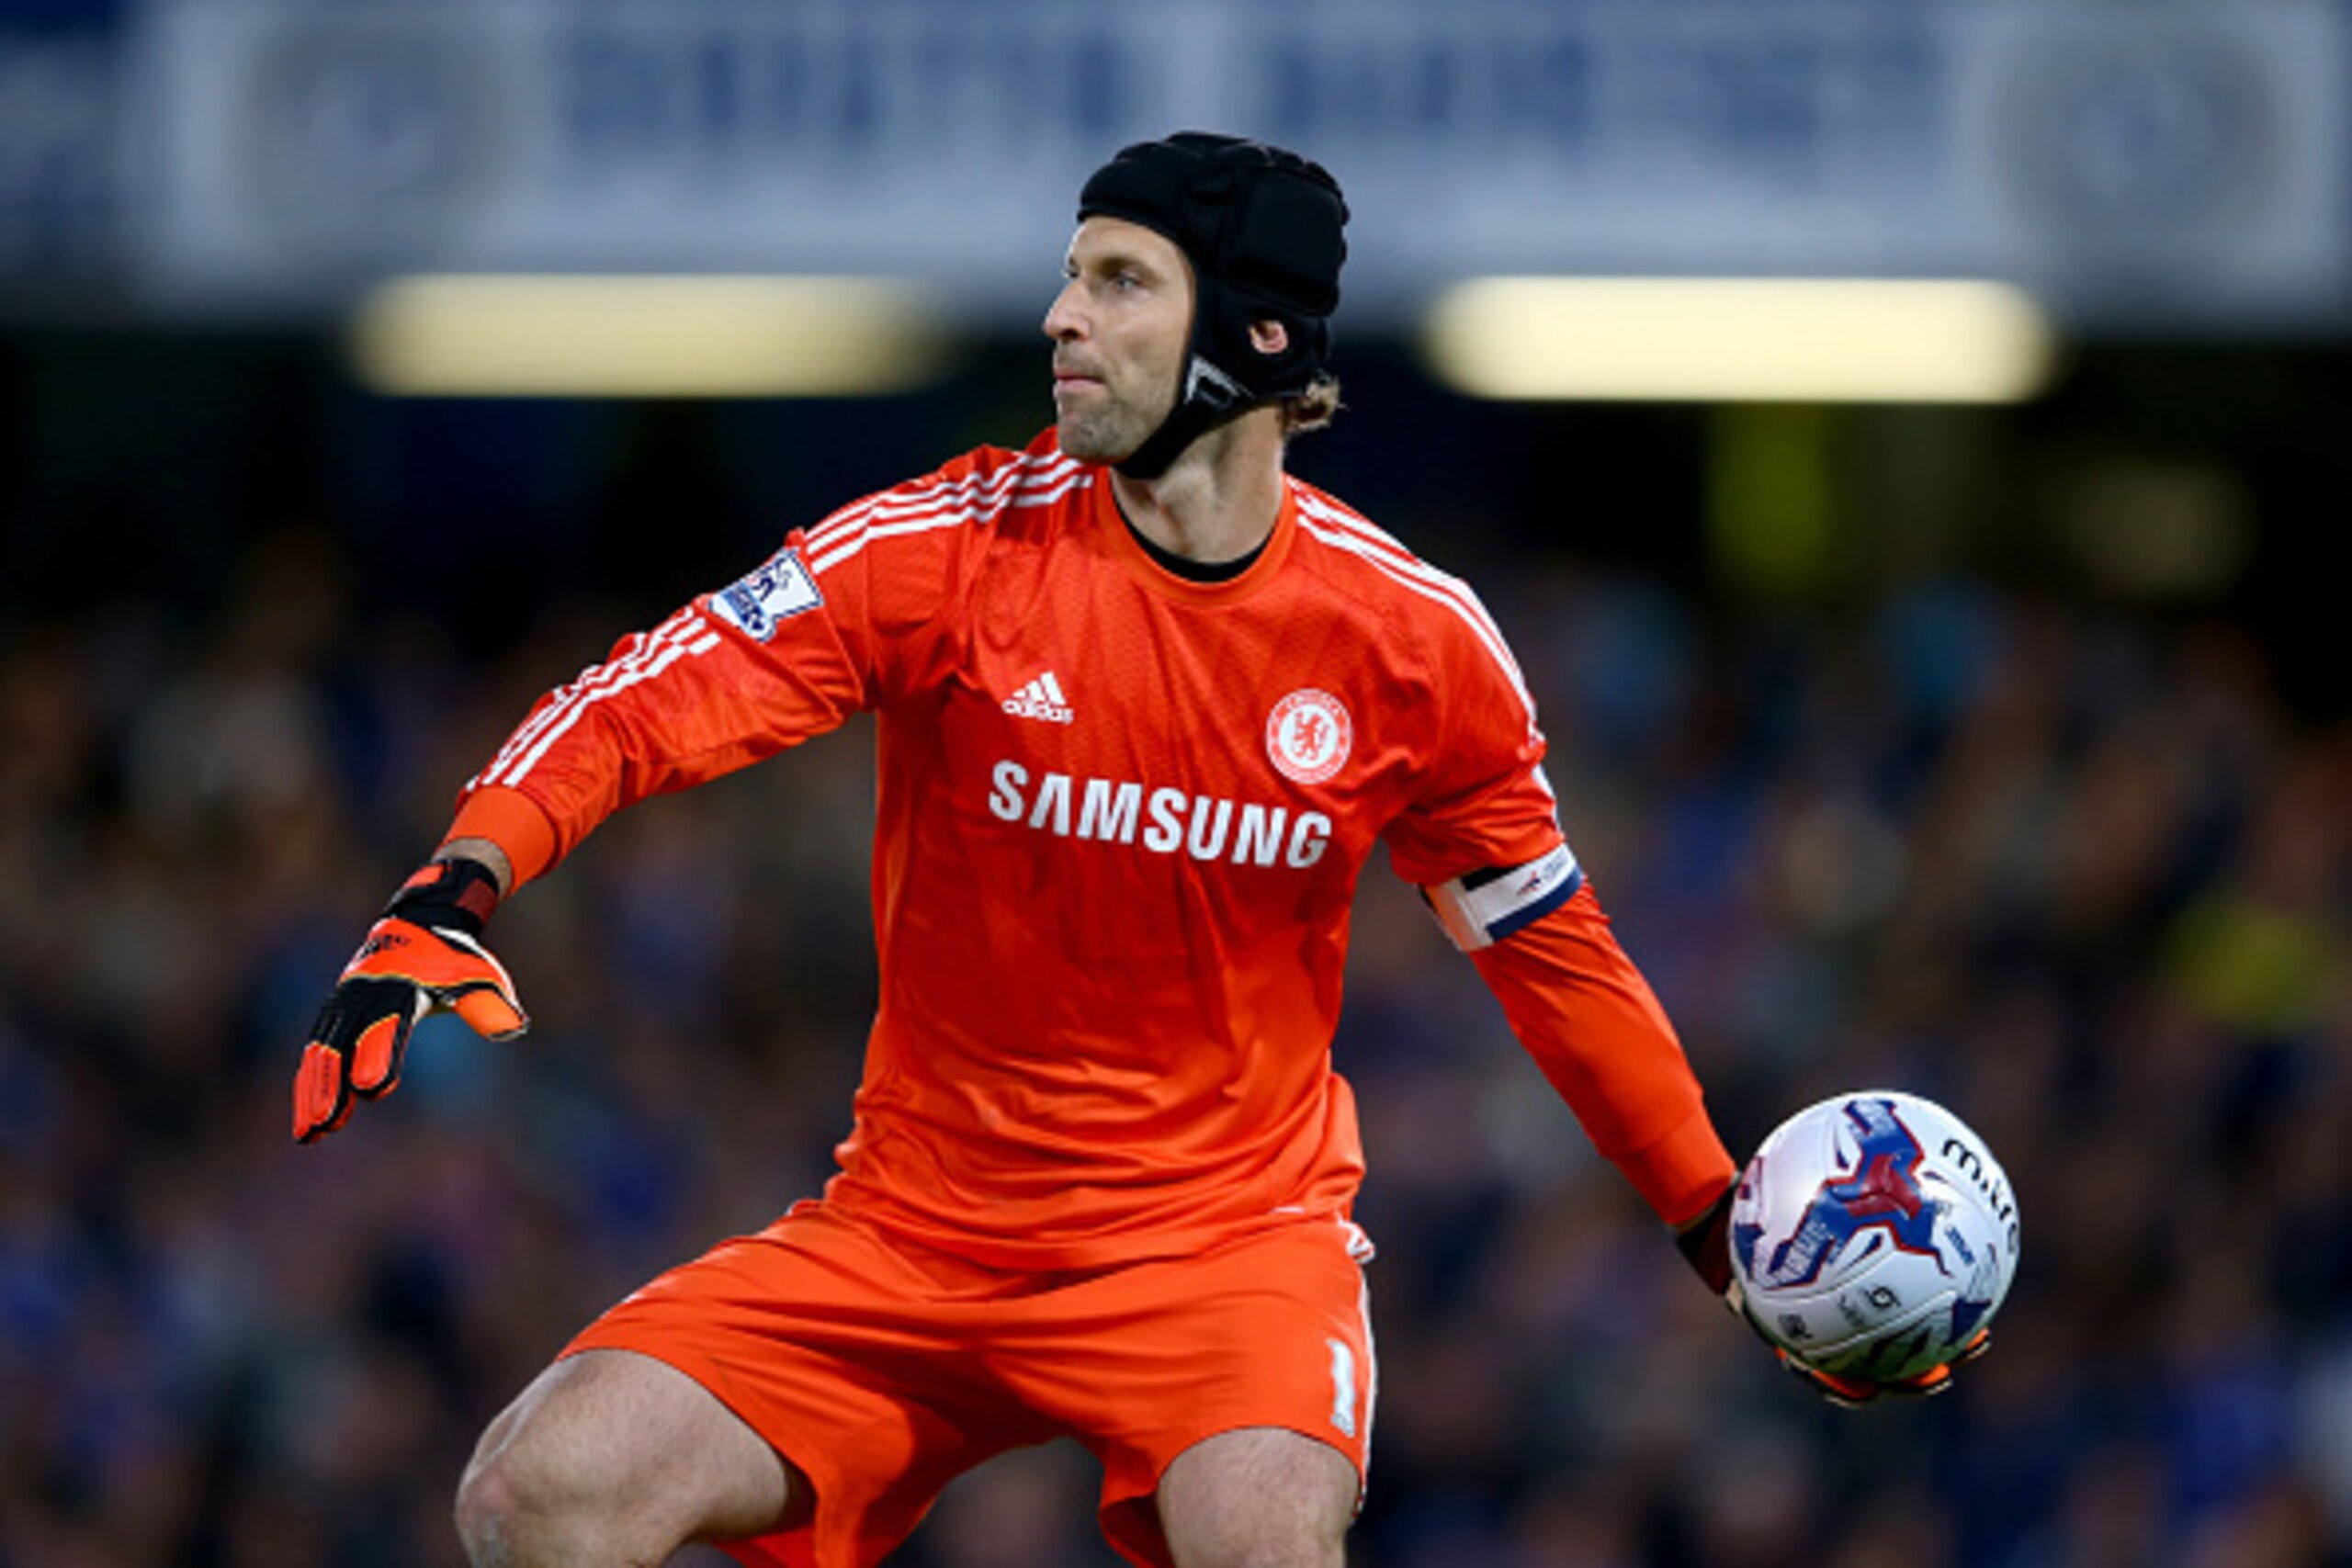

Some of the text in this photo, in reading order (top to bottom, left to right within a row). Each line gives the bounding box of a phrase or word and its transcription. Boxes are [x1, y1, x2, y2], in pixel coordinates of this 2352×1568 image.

[1002, 699, 1074, 725] adidas
[989, 759, 1332, 870] SAMSUNG
[1327, 1337, 1356, 1438] 1
